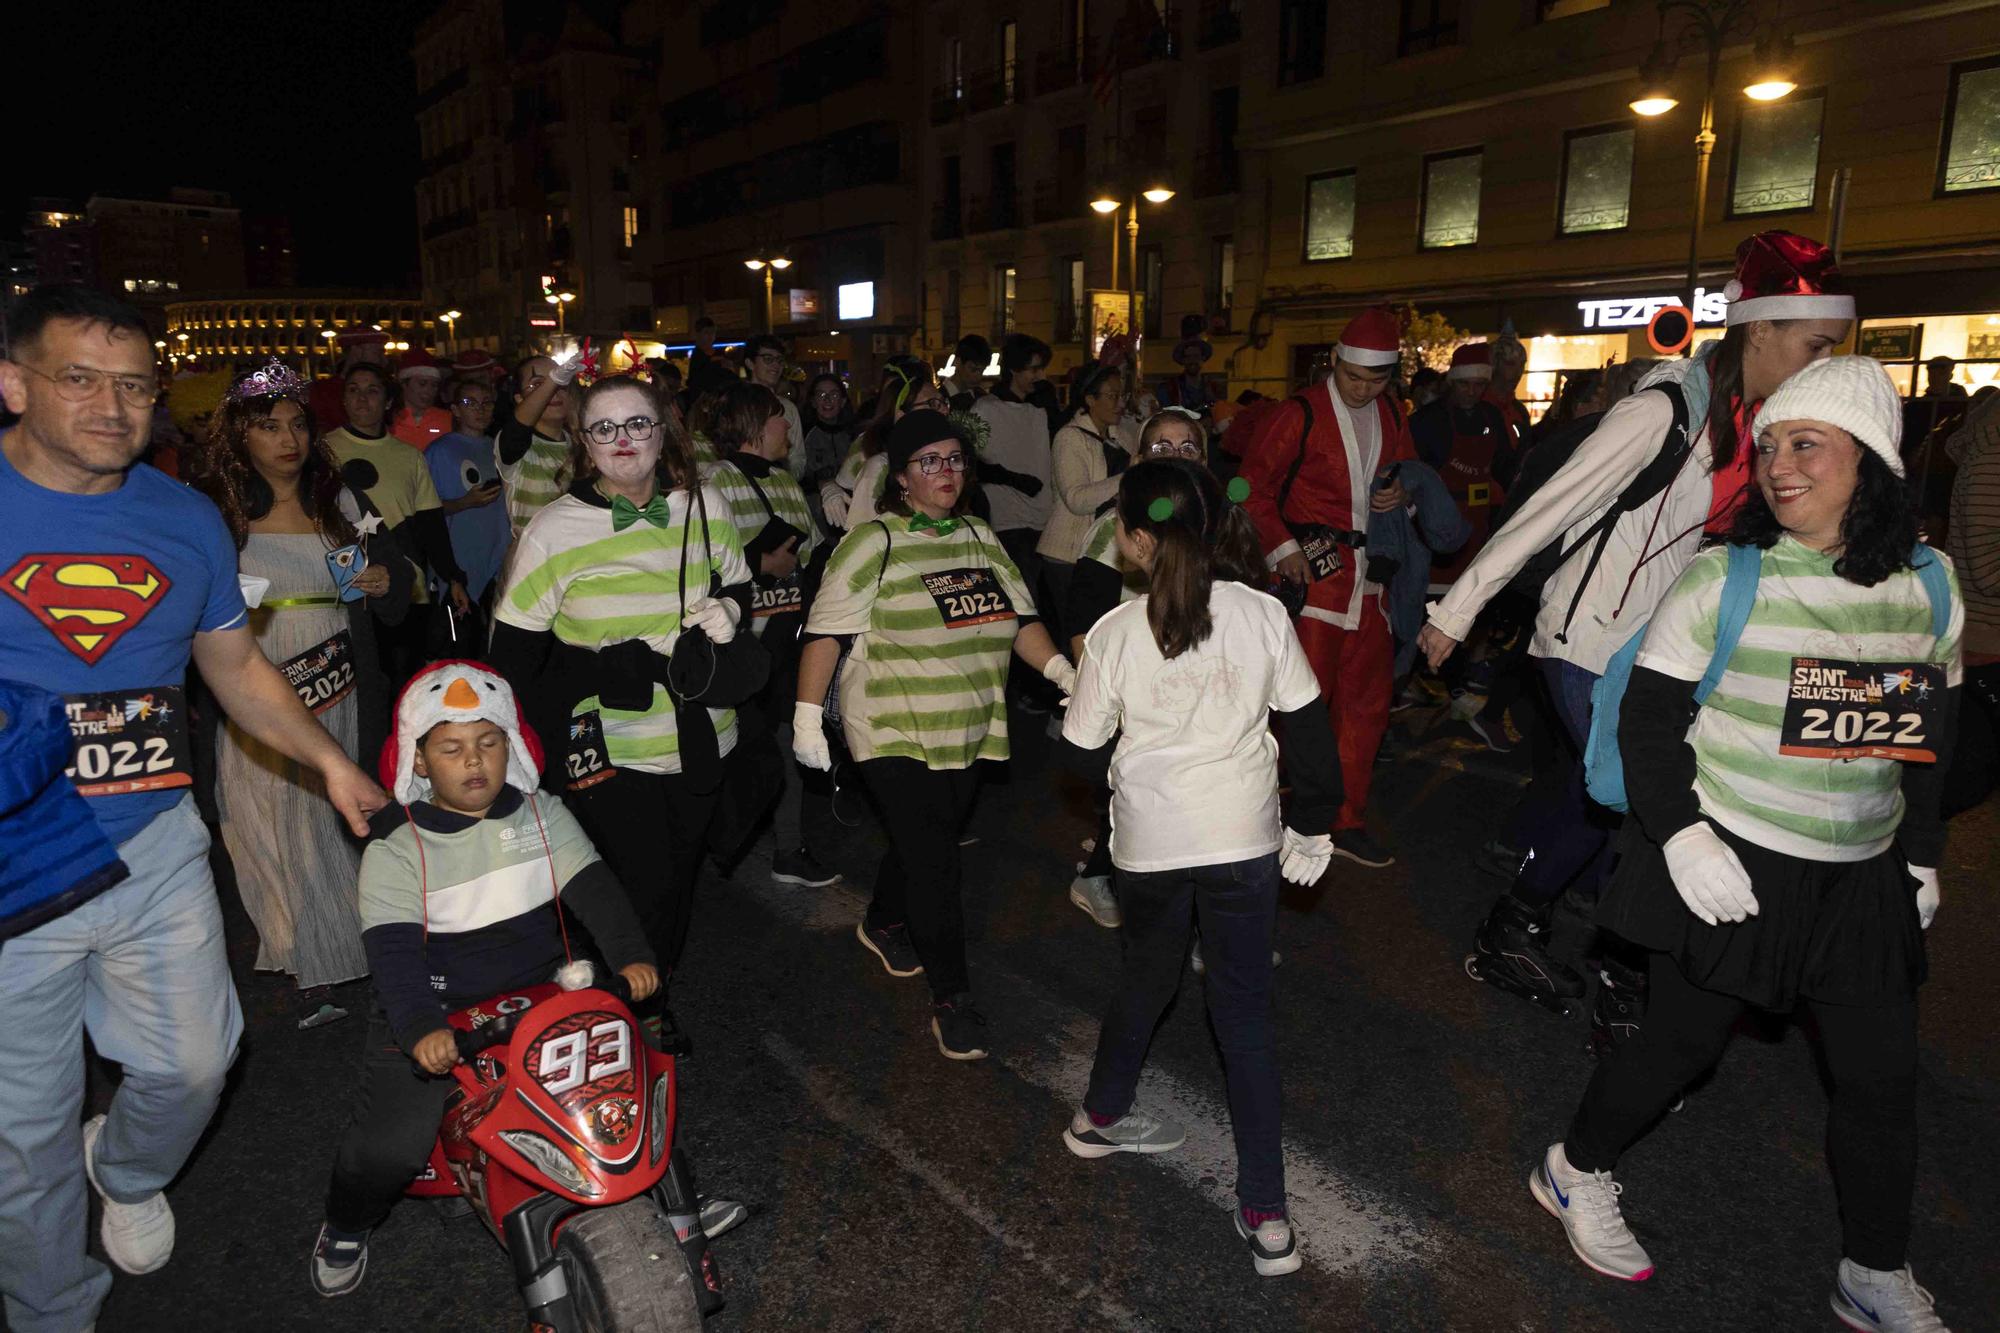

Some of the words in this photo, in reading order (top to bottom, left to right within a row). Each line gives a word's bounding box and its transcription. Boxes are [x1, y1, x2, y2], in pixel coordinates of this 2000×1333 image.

[925, 575, 953, 589] SANT
[752, 586, 802, 609] 2022
[944, 592, 1005, 618] 2022
[298, 662, 355, 707] 2022
[1793, 667, 1847, 687] SANT
[1801, 708, 1926, 744] 2022
[565, 748, 603, 779] 22
[538, 1019, 632, 1096] 93
